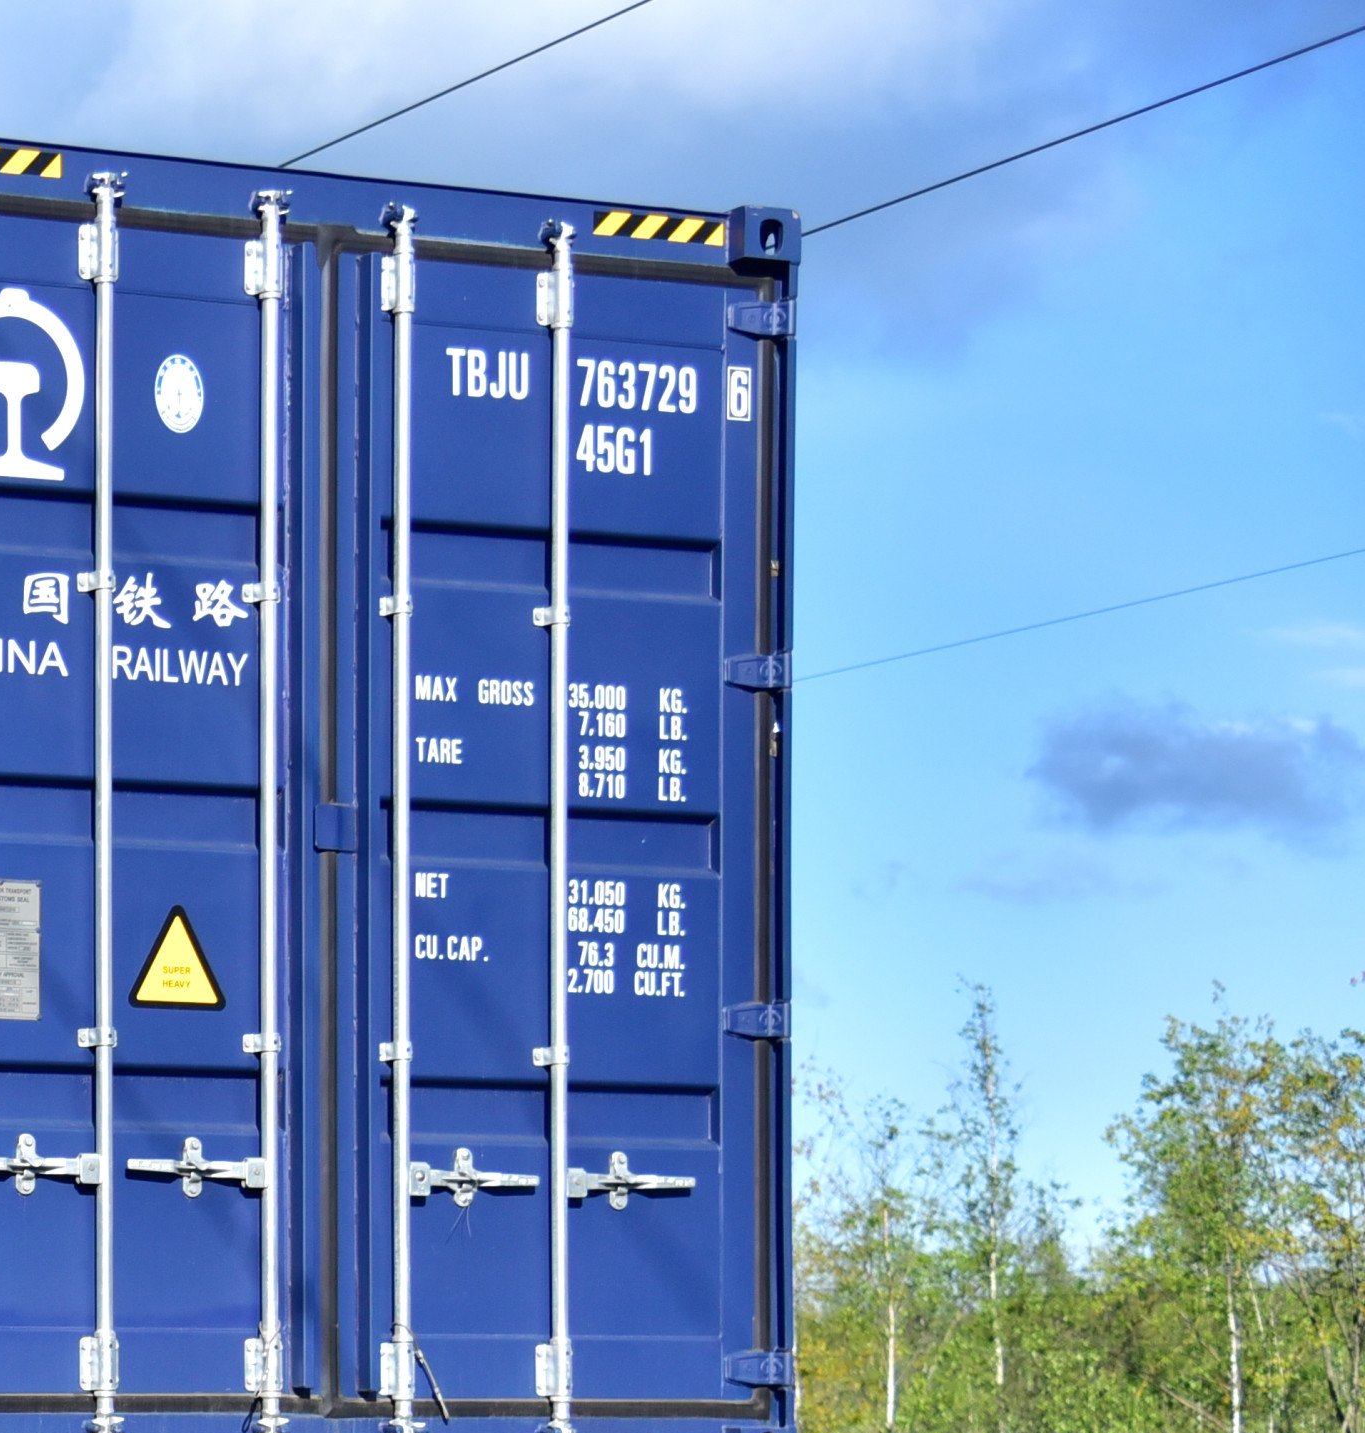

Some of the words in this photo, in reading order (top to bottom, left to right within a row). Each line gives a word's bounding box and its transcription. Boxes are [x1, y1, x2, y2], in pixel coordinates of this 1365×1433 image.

[446, 347, 529, 400] TBJU
[577, 358, 697, 414] 763729
[730, 370, 749, 418] 6
[576, 424, 652, 476] 45G1
[112, 645, 249, 687] RAILWAY
[415, 675, 458, 702] MAX
[477, 678, 535, 707] GROSS
[659, 687, 688, 714] KG.
[659, 715, 688, 741] LB.
[415, 737, 463, 765] TARE
[658, 748, 687, 775] KG.
[657, 776, 687, 802] LB.
[415, 872, 450, 899] NET
[657, 883, 686, 909] KG.
[657, 910, 686, 937] LB.
[163, 966, 191, 974] SUPER
[414, 934, 489, 962] CU.CAP.
[577, 941, 615, 967] 76.3
[636, 943, 686, 970] CU.M.
[162, 980, 191, 988] HEAVY
[634, 971, 685, 998] CU.FT.
